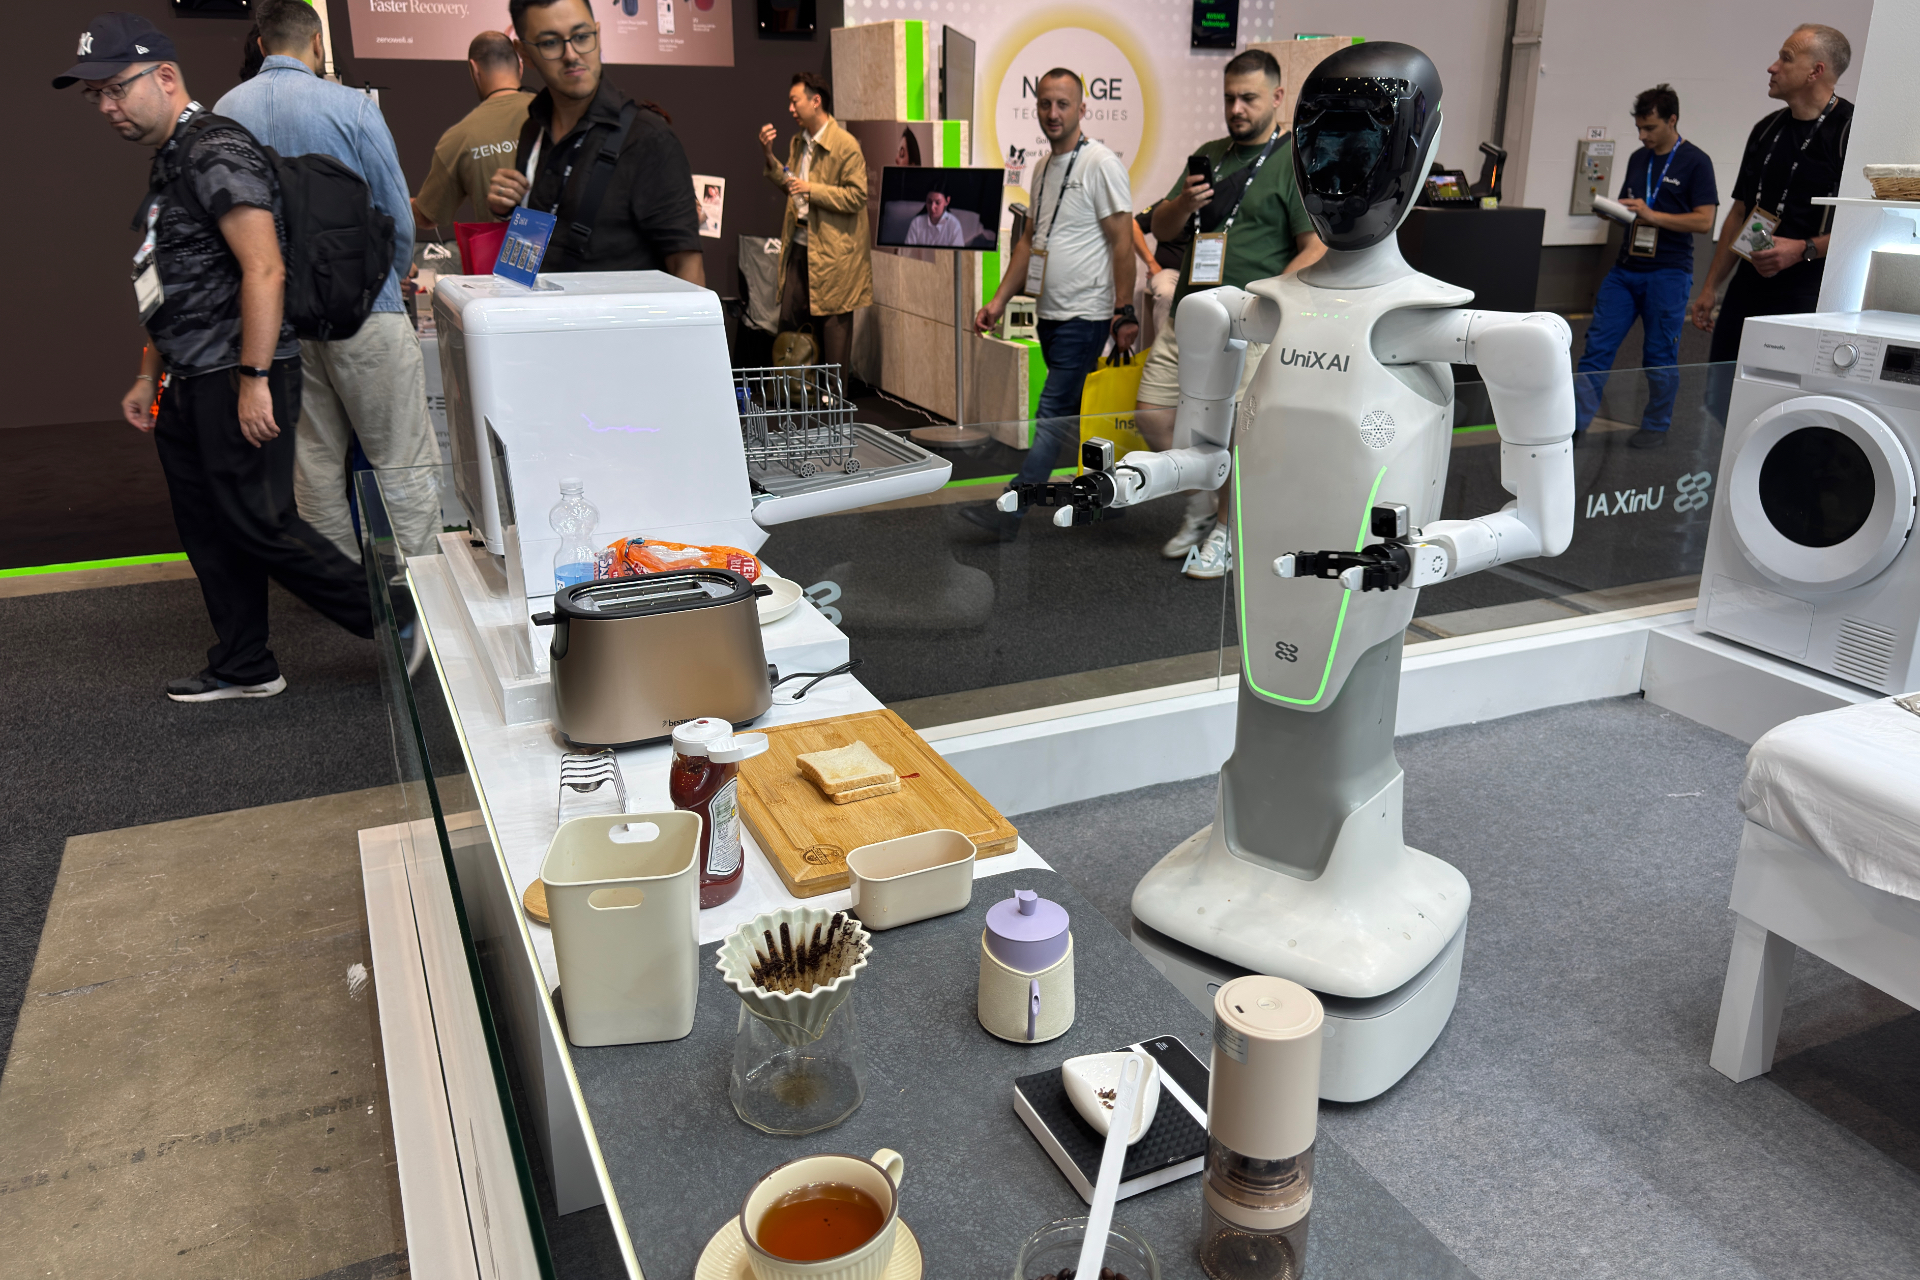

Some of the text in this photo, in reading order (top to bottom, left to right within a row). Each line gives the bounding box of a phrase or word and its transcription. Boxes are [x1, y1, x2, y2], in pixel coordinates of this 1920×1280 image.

[370, 0, 470, 19] Faster Recovery.
[1013, 107, 1129, 122] TECOGIES
